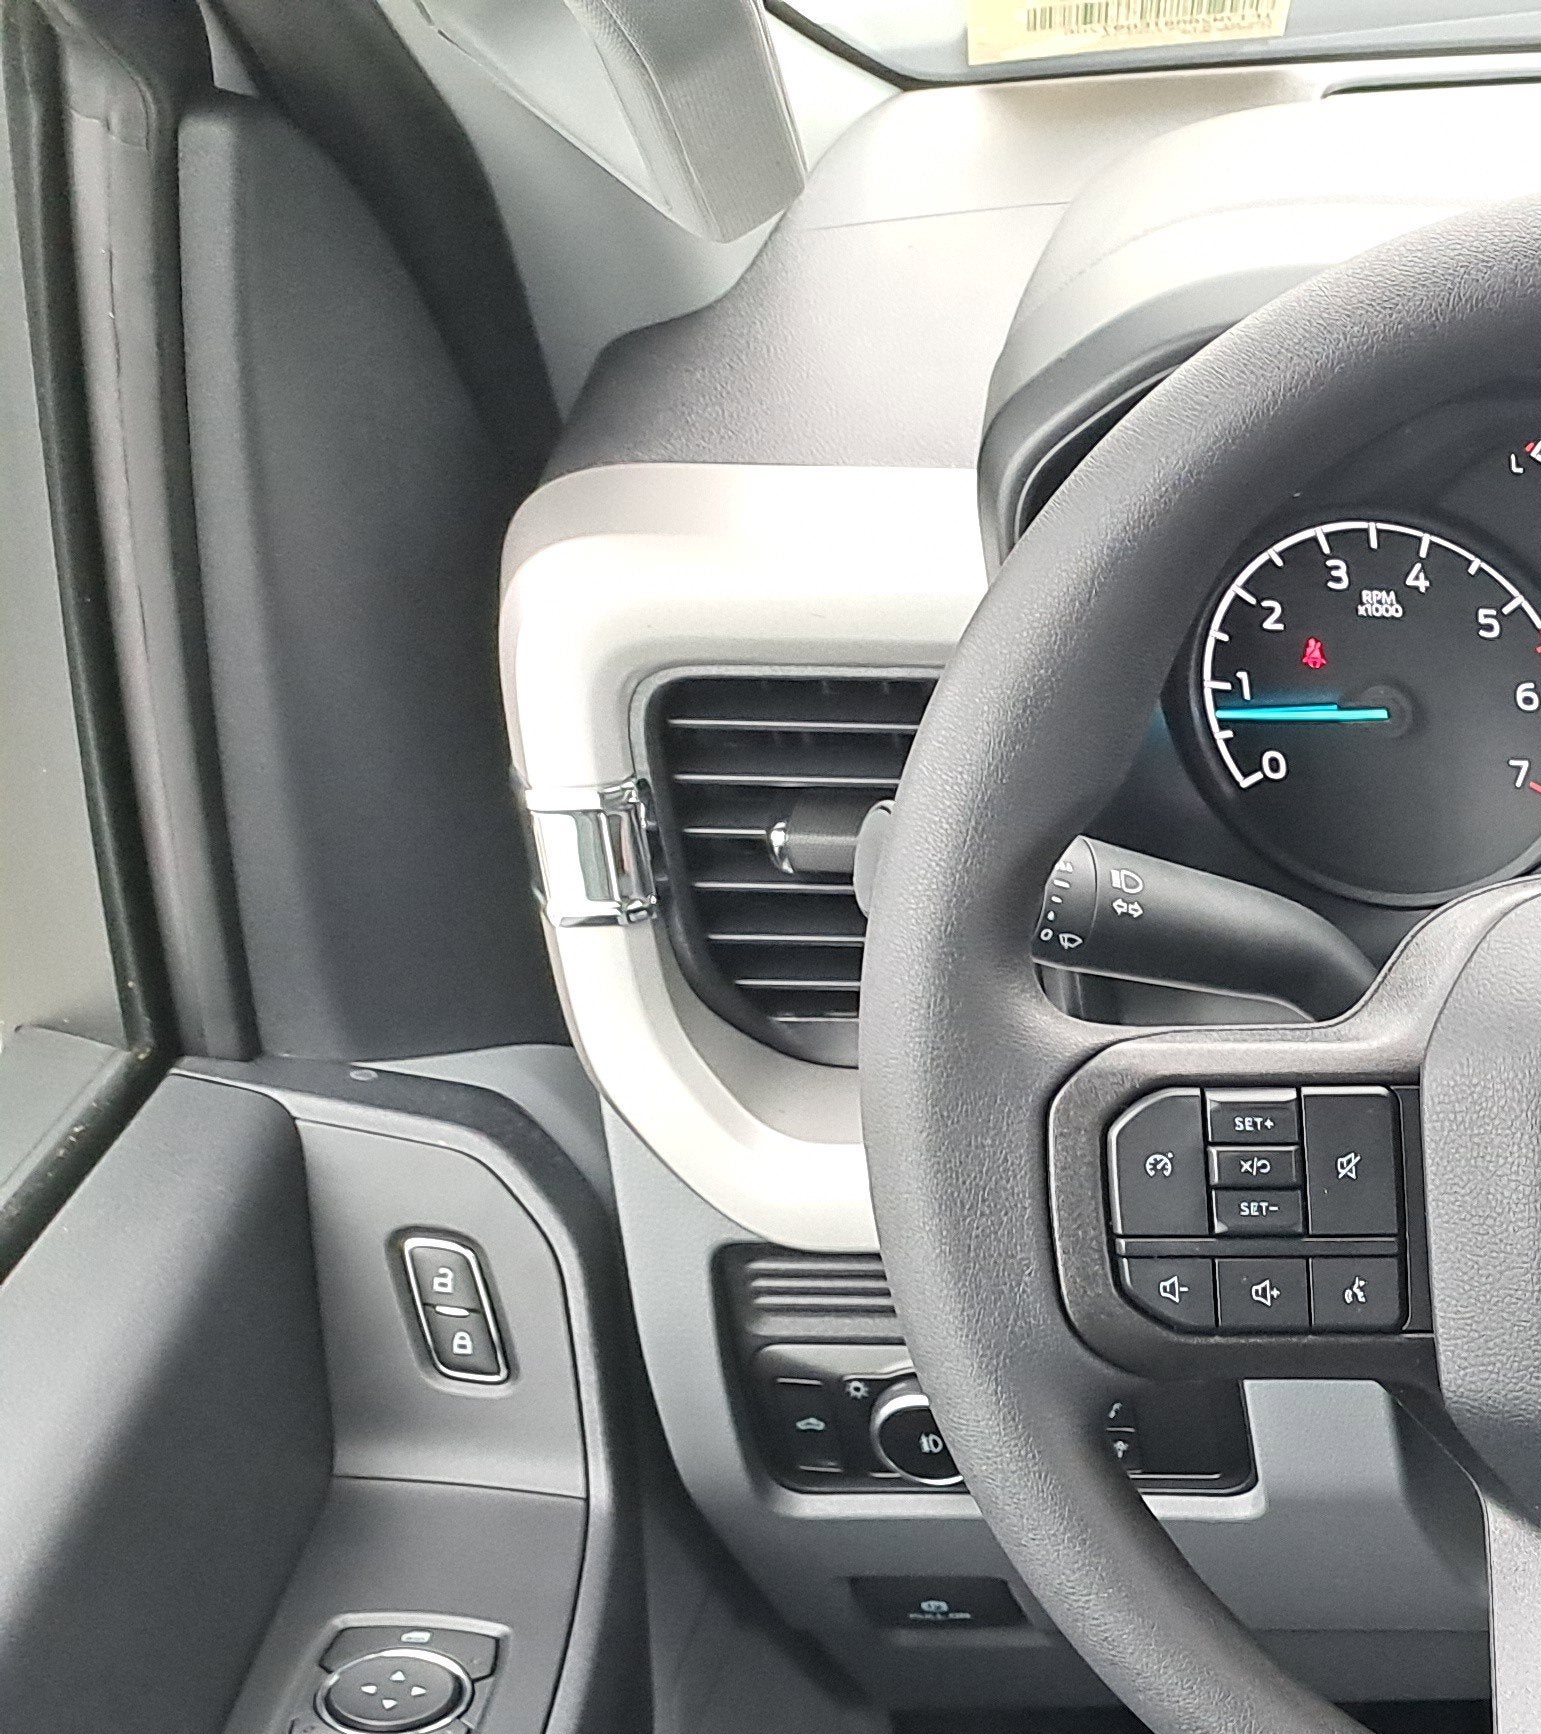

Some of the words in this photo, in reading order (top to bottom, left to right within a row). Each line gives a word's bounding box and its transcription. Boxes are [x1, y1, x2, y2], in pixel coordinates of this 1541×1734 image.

[1511, 454, 1523, 474] L
[1326, 559, 1349, 590] 3
[1406, 563, 1430, 593] 4
[1361, 590, 1396, 606] RPM
[1262, 601, 1285, 631] 2
[1478, 609, 1501, 639] 5
[1235, 671, 1251, 700] 1
[1515, 683, 1540, 711] 6
[1262, 751, 1287, 780] 0
[1508, 759, 1531, 787] 7
[1234, 1117, 1275, 1131] SET+
